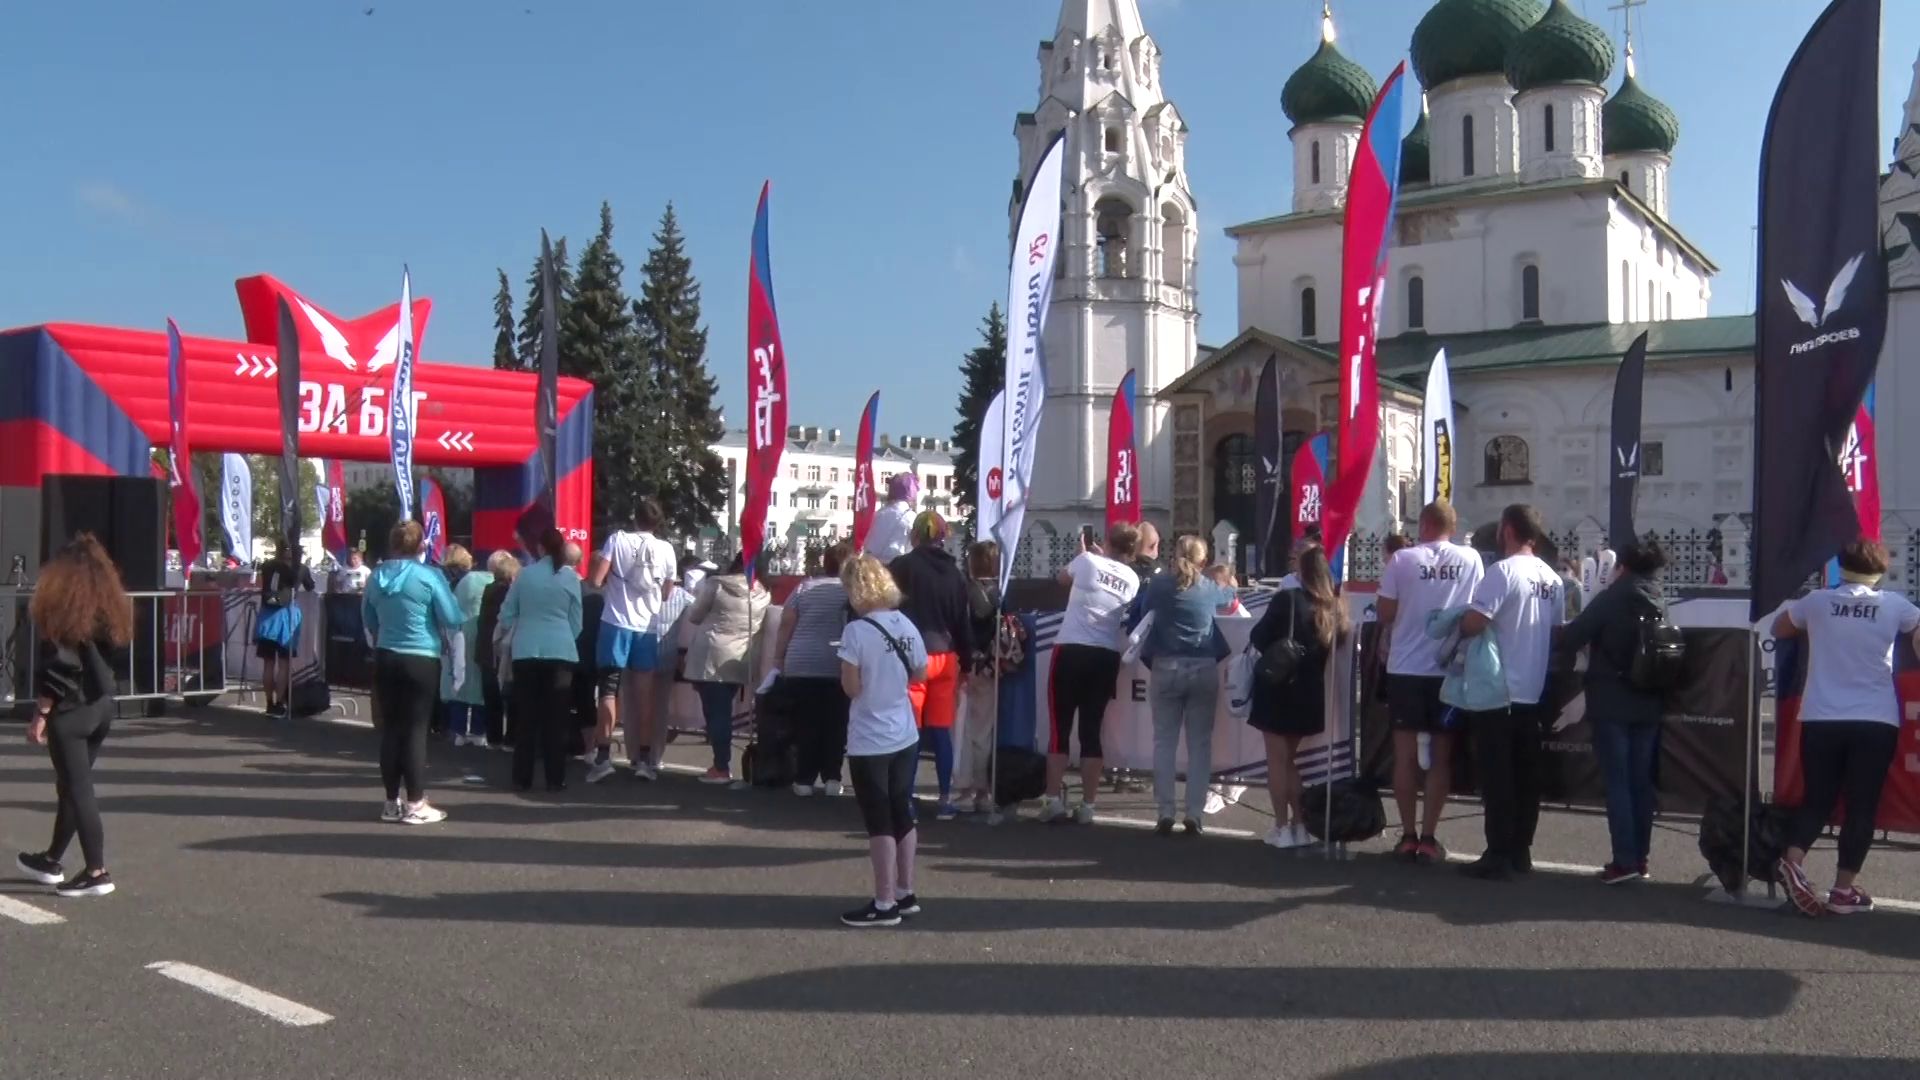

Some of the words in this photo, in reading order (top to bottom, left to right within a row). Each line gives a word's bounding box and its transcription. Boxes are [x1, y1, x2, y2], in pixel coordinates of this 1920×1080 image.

[298, 381, 348, 434] ЗА
[359, 386, 428, 441] БГ
[1420, 564, 1437, 580] ЗА
[1831, 602, 1849, 617] ЗА
[1853, 604, 1880, 618] БЕГ
